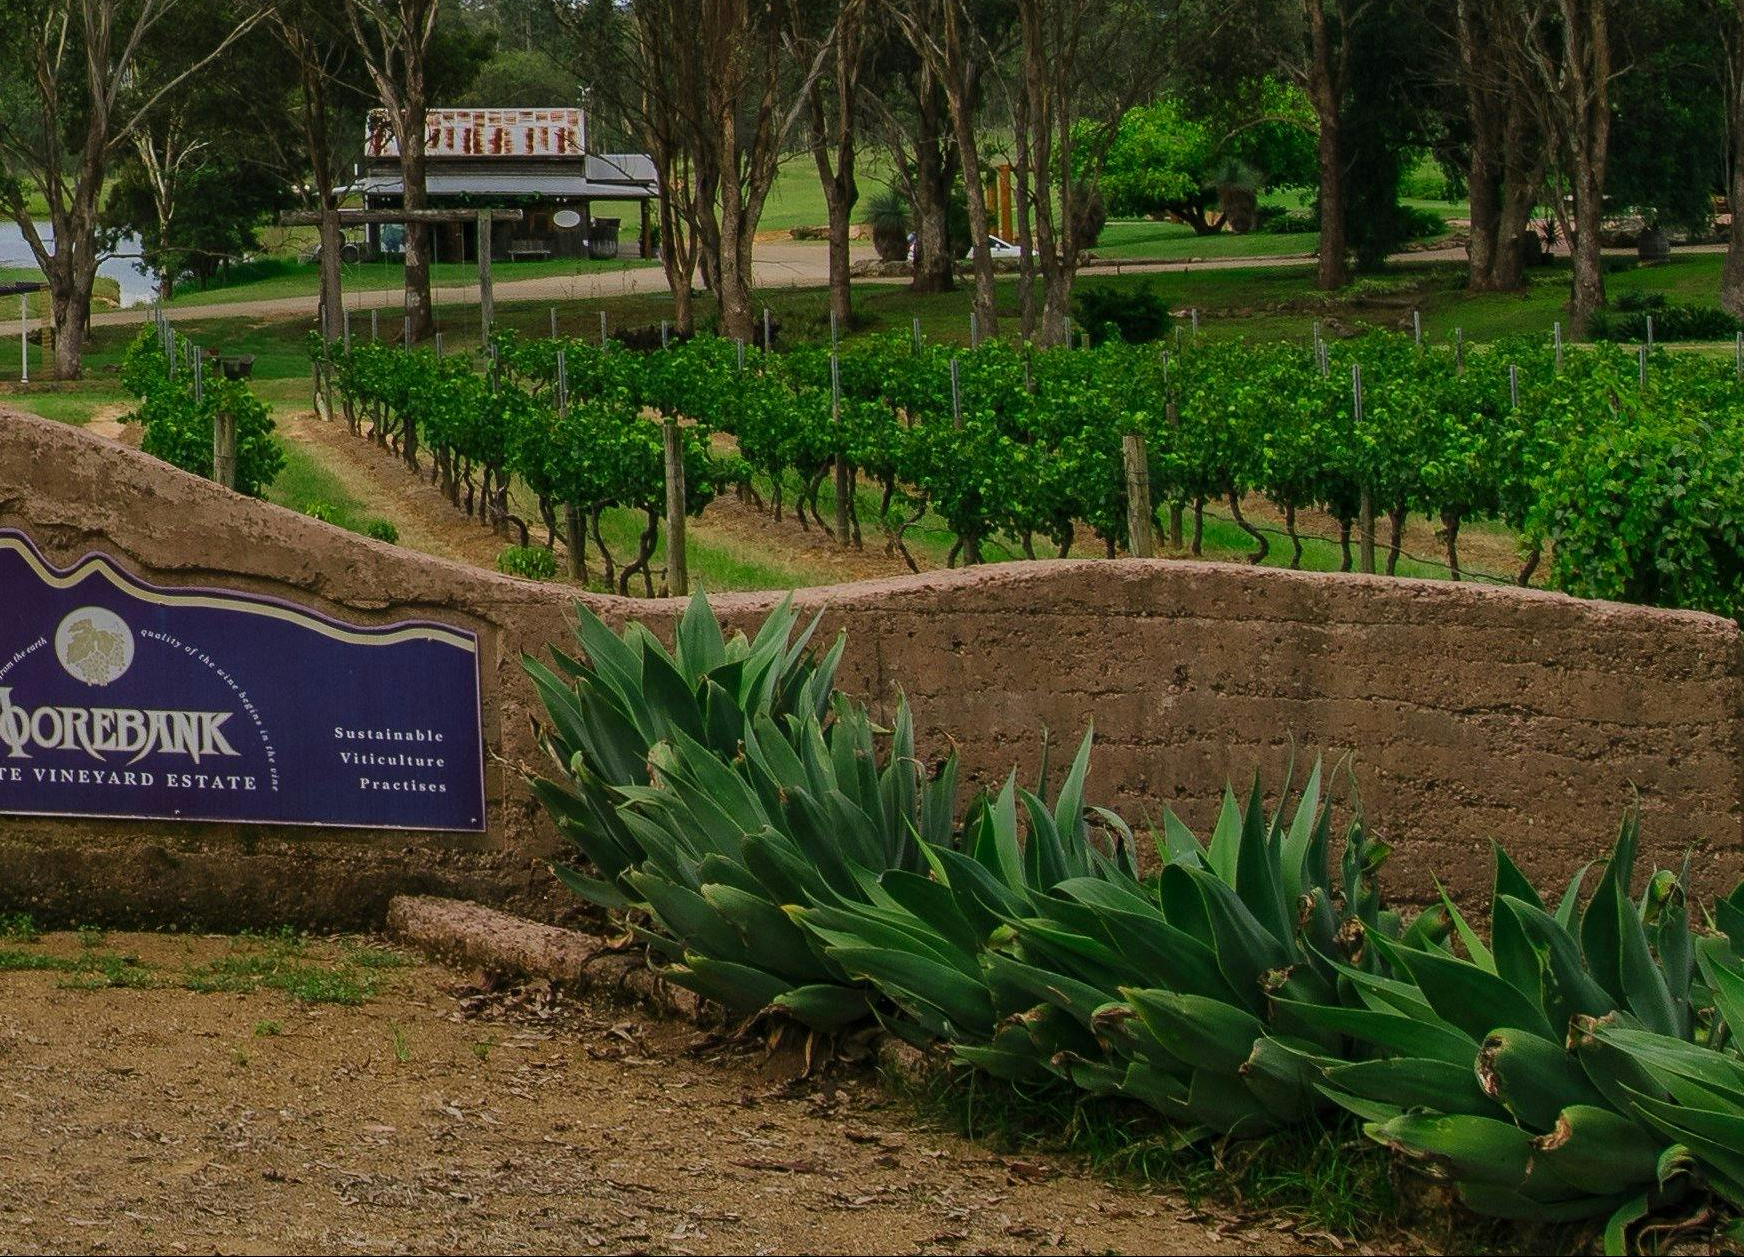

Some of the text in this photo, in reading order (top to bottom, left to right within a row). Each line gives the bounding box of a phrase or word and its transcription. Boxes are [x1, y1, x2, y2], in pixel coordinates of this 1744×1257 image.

[13, 650, 26, 663] the
[26, 636, 47, 654] earth
[140, 628, 182, 648] quality
[184, 645, 199, 656] of
[198, 654, 215, 668] the
[217, 669, 239, 690] wine
[239, 691, 262, 726] begins
[260, 729, 269, 742] in
[265, 745, 276, 763] the
[334, 726, 443, 742] Sustainable
[340, 752, 445, 767] Viticulture
[33, 768, 154, 786] VINEYARD
[167, 773, 256, 790] ESTATE
[360, 777, 446, 793] Practises
